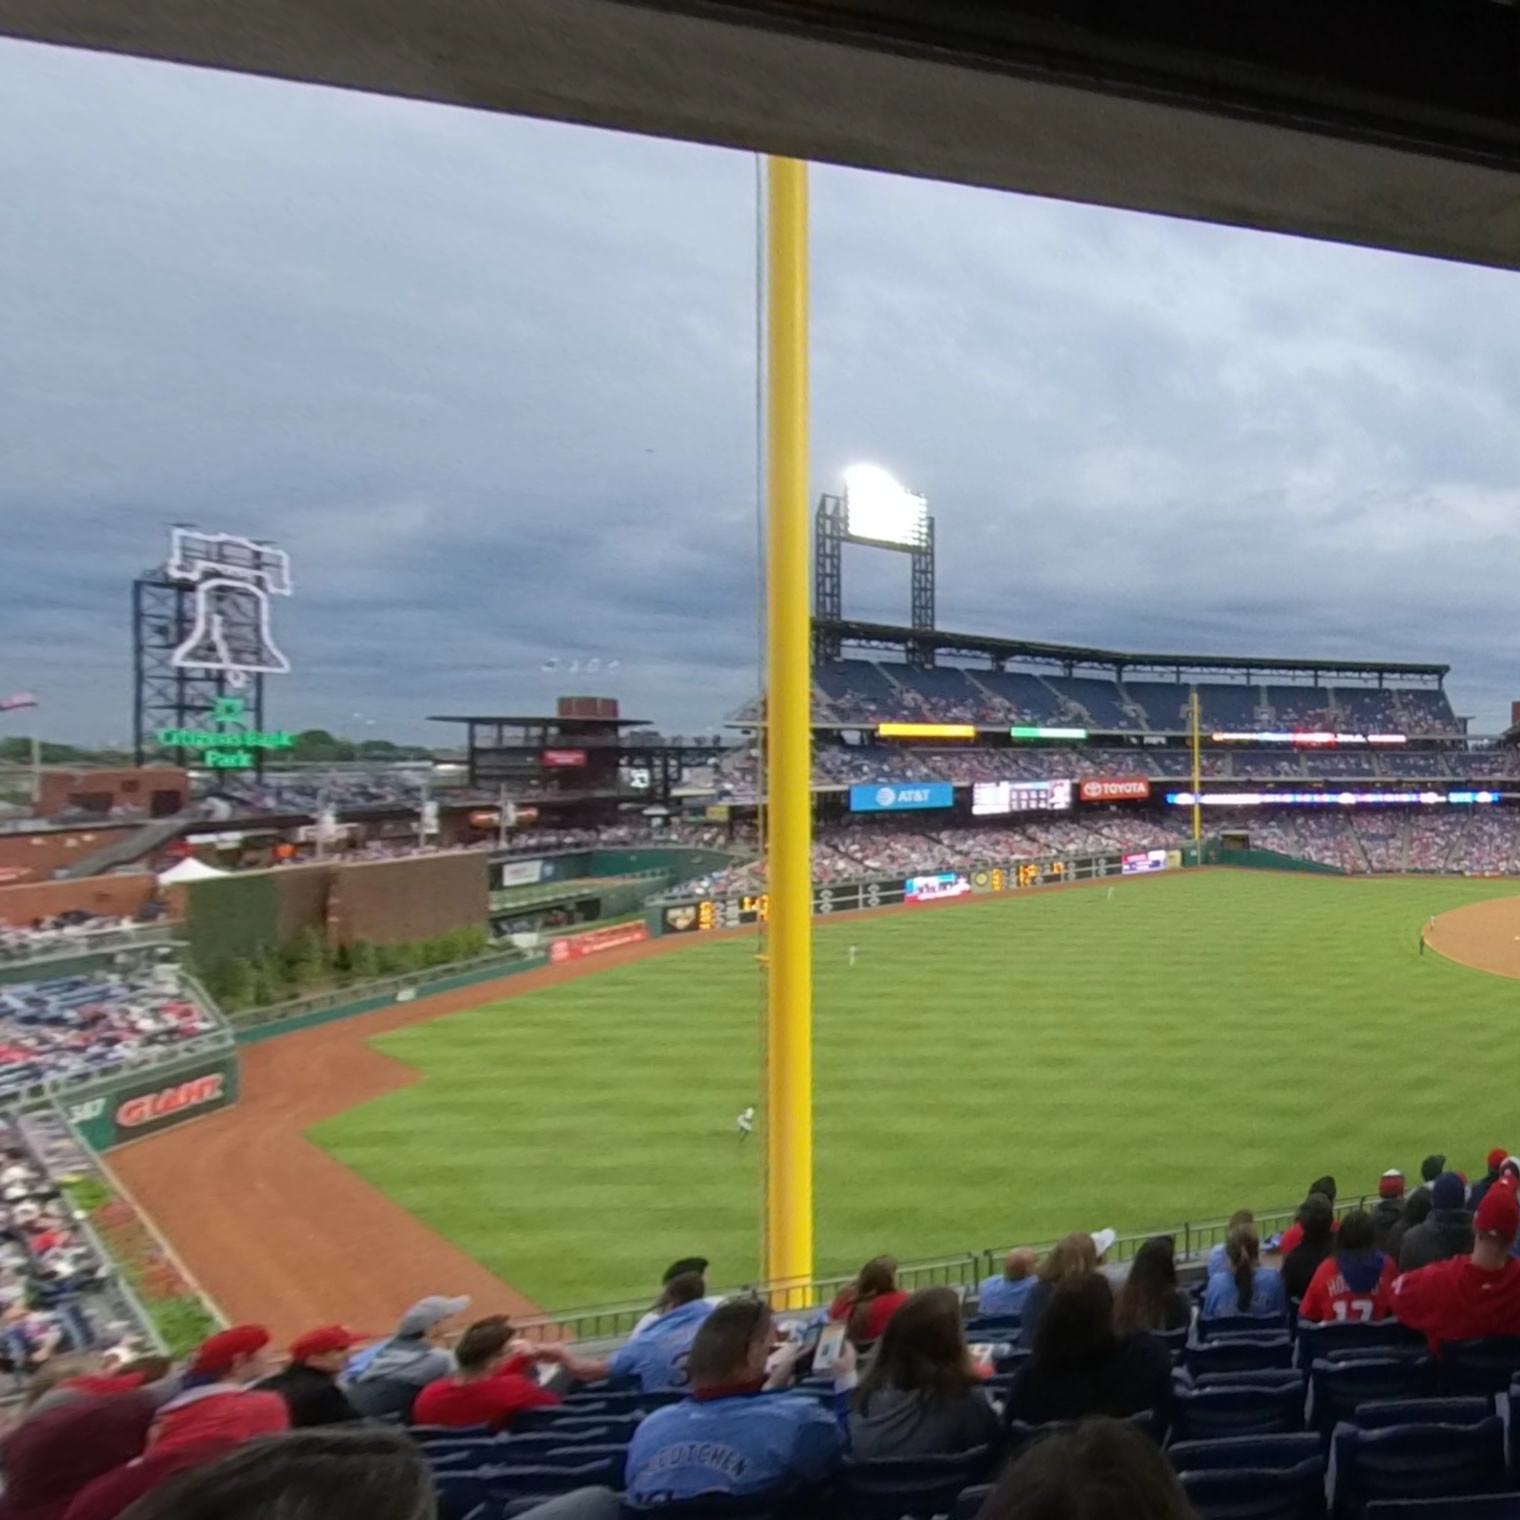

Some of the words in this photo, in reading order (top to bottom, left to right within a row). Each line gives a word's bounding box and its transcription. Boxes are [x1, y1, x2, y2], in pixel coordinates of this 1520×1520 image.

[205, 750, 253, 767] Park
[898, 789, 930, 801] AT&T
[1103, 783, 1146, 794] TOYOTA
[116, 1073, 224, 1127] GIANT
[1332, 1300, 1374, 1322] 17
